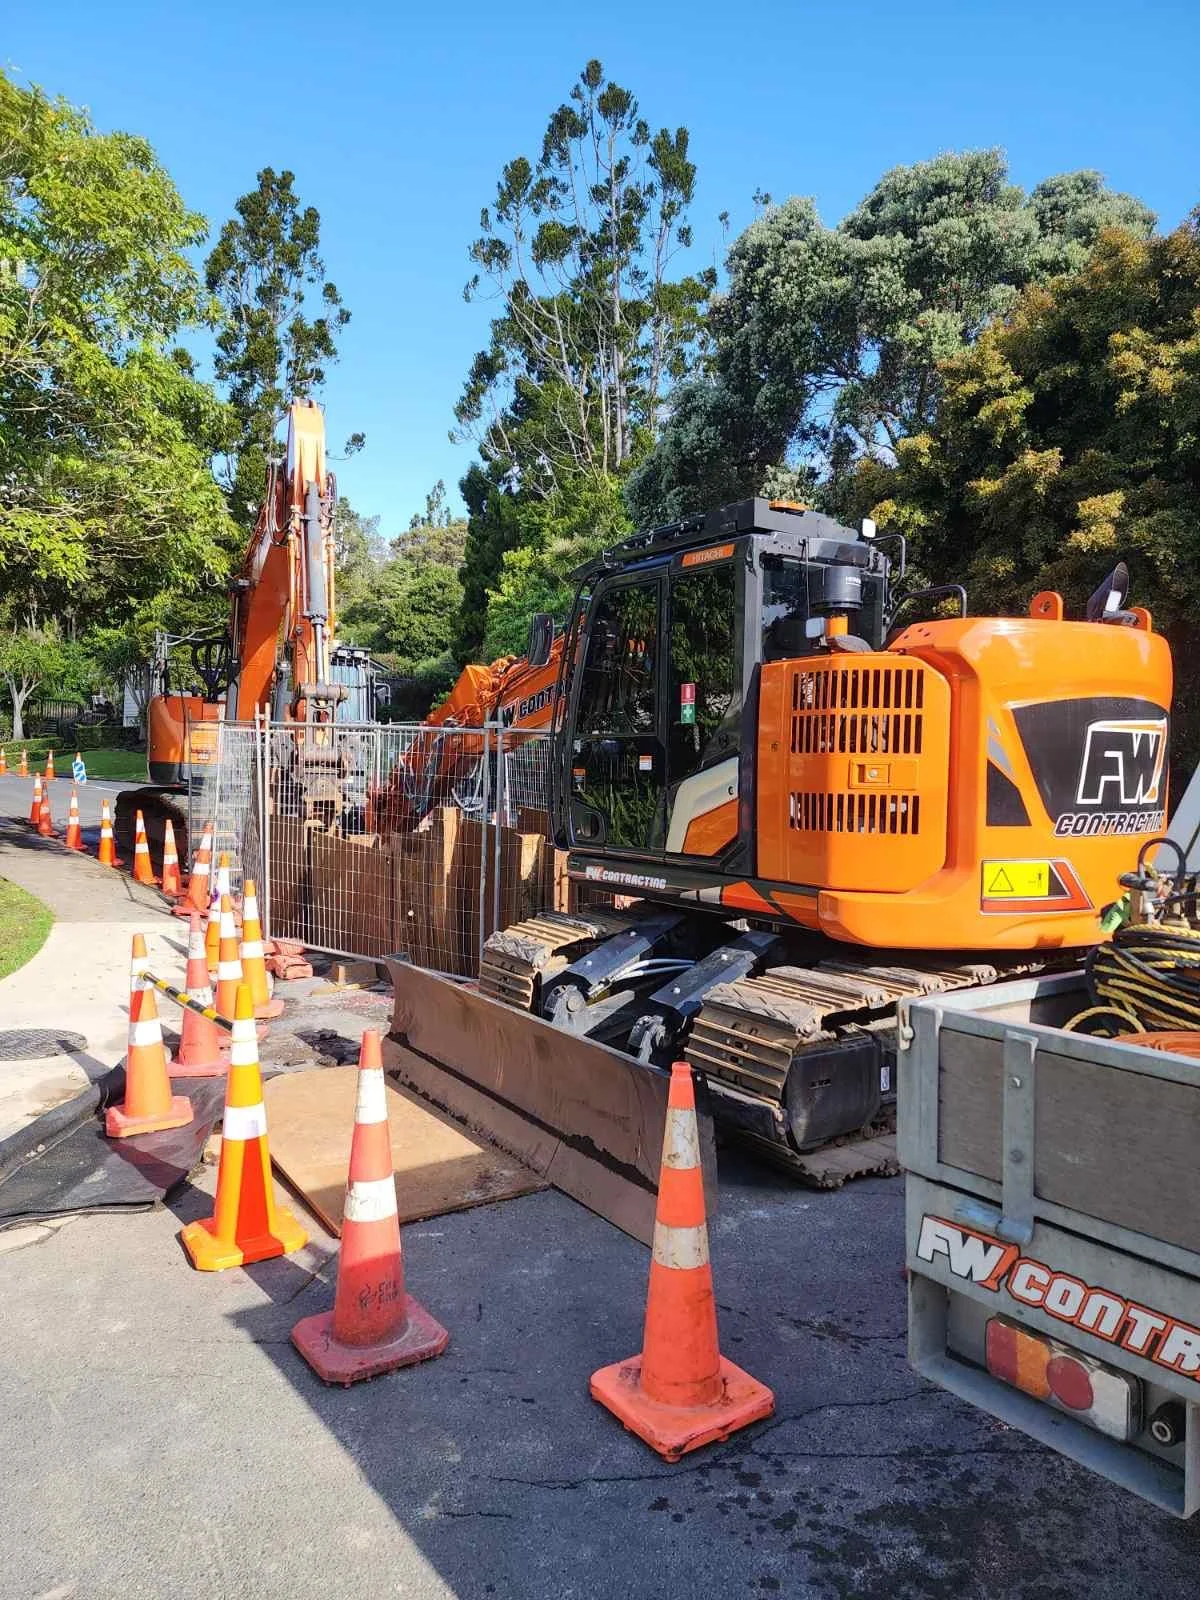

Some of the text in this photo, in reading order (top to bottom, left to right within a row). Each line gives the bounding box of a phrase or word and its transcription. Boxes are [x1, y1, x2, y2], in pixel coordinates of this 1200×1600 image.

[1076, 717, 1167, 805] FW
[585, 866, 667, 889] FW CONTRACTING
[916, 1215, 1017, 1290] FW
